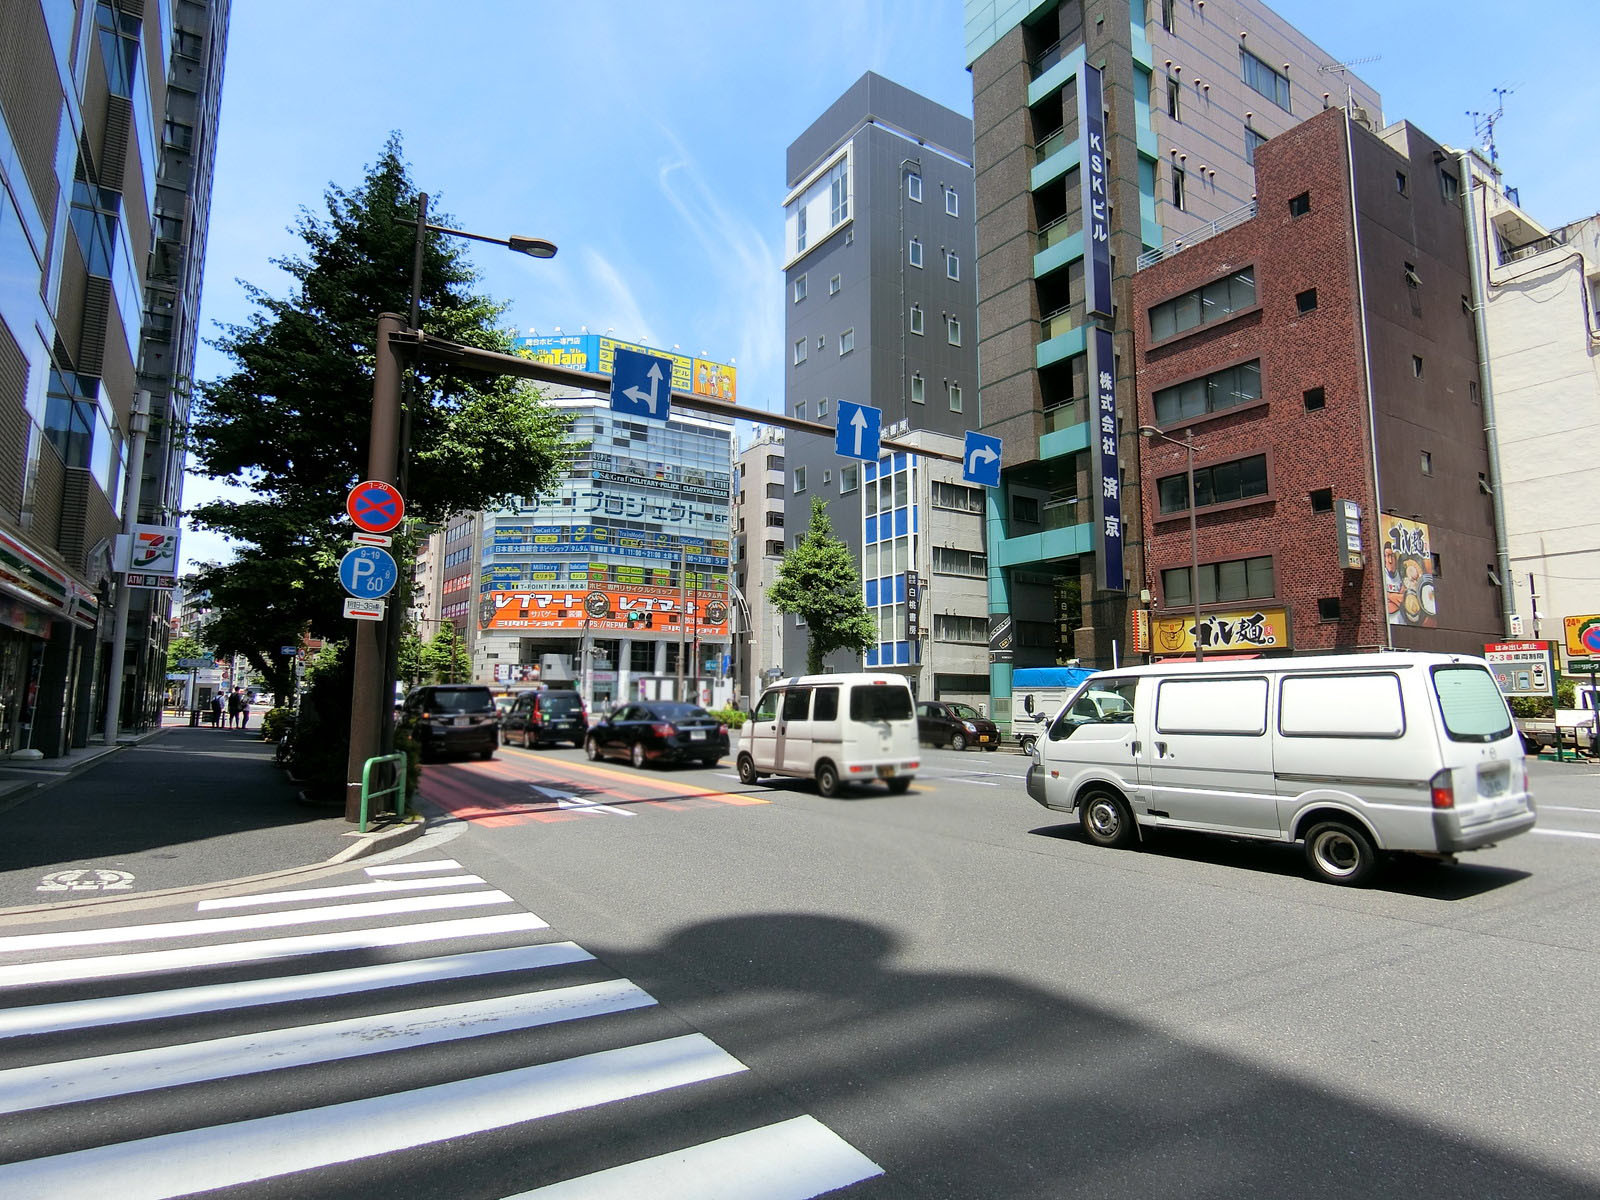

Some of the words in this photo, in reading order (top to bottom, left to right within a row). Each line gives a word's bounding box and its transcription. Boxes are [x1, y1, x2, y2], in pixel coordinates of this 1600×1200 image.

[1090, 132, 1107, 242] KSKビル
[1100, 371, 1116, 456] 株式会社
[368, 482, 388, 491] 7-20
[361, 550, 381, 559] 9-19
[128, 575, 142, 585] ATM
[352, 557, 375, 590] P
[366, 577, 383, 592] 60
[495, 592, 583, 608] レプマート
